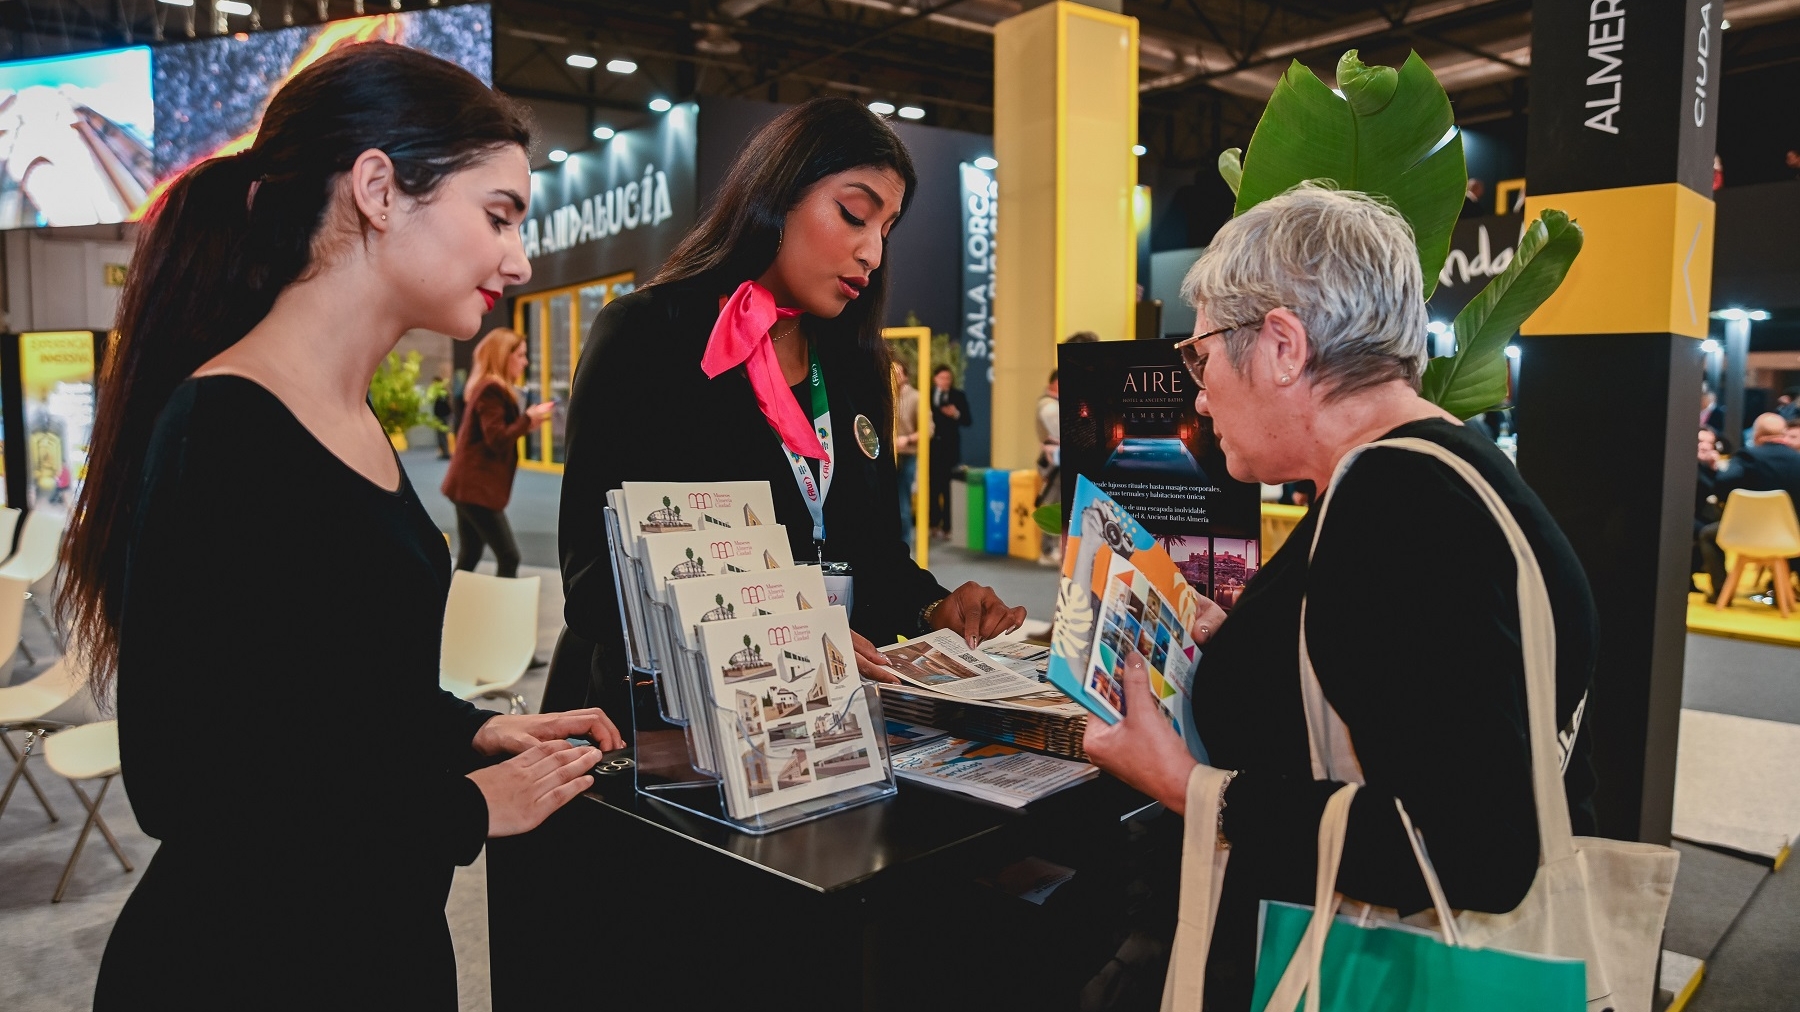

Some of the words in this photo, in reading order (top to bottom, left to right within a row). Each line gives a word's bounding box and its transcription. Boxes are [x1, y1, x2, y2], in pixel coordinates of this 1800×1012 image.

[1694, 2, 1713, 128] CIUDA
[966, 284, 988, 359] SALA
[1123, 370, 1183, 394] AIRE
[1108, 482, 1127, 490] lujosos
[1128, 482, 1149, 490] rituales
[1165, 485, 1188, 493] masajes
[1150, 491, 1186, 500] habitaciones
[1186, 493, 1206, 501] únicas
[1128, 503, 1136, 511] de
[1147, 505, 1174, 514] escapada
[1174, 506, 1207, 515] inolvidable
[1169, 514, 1186, 522] Baths
[1186, 515, 1210, 523] Almería
